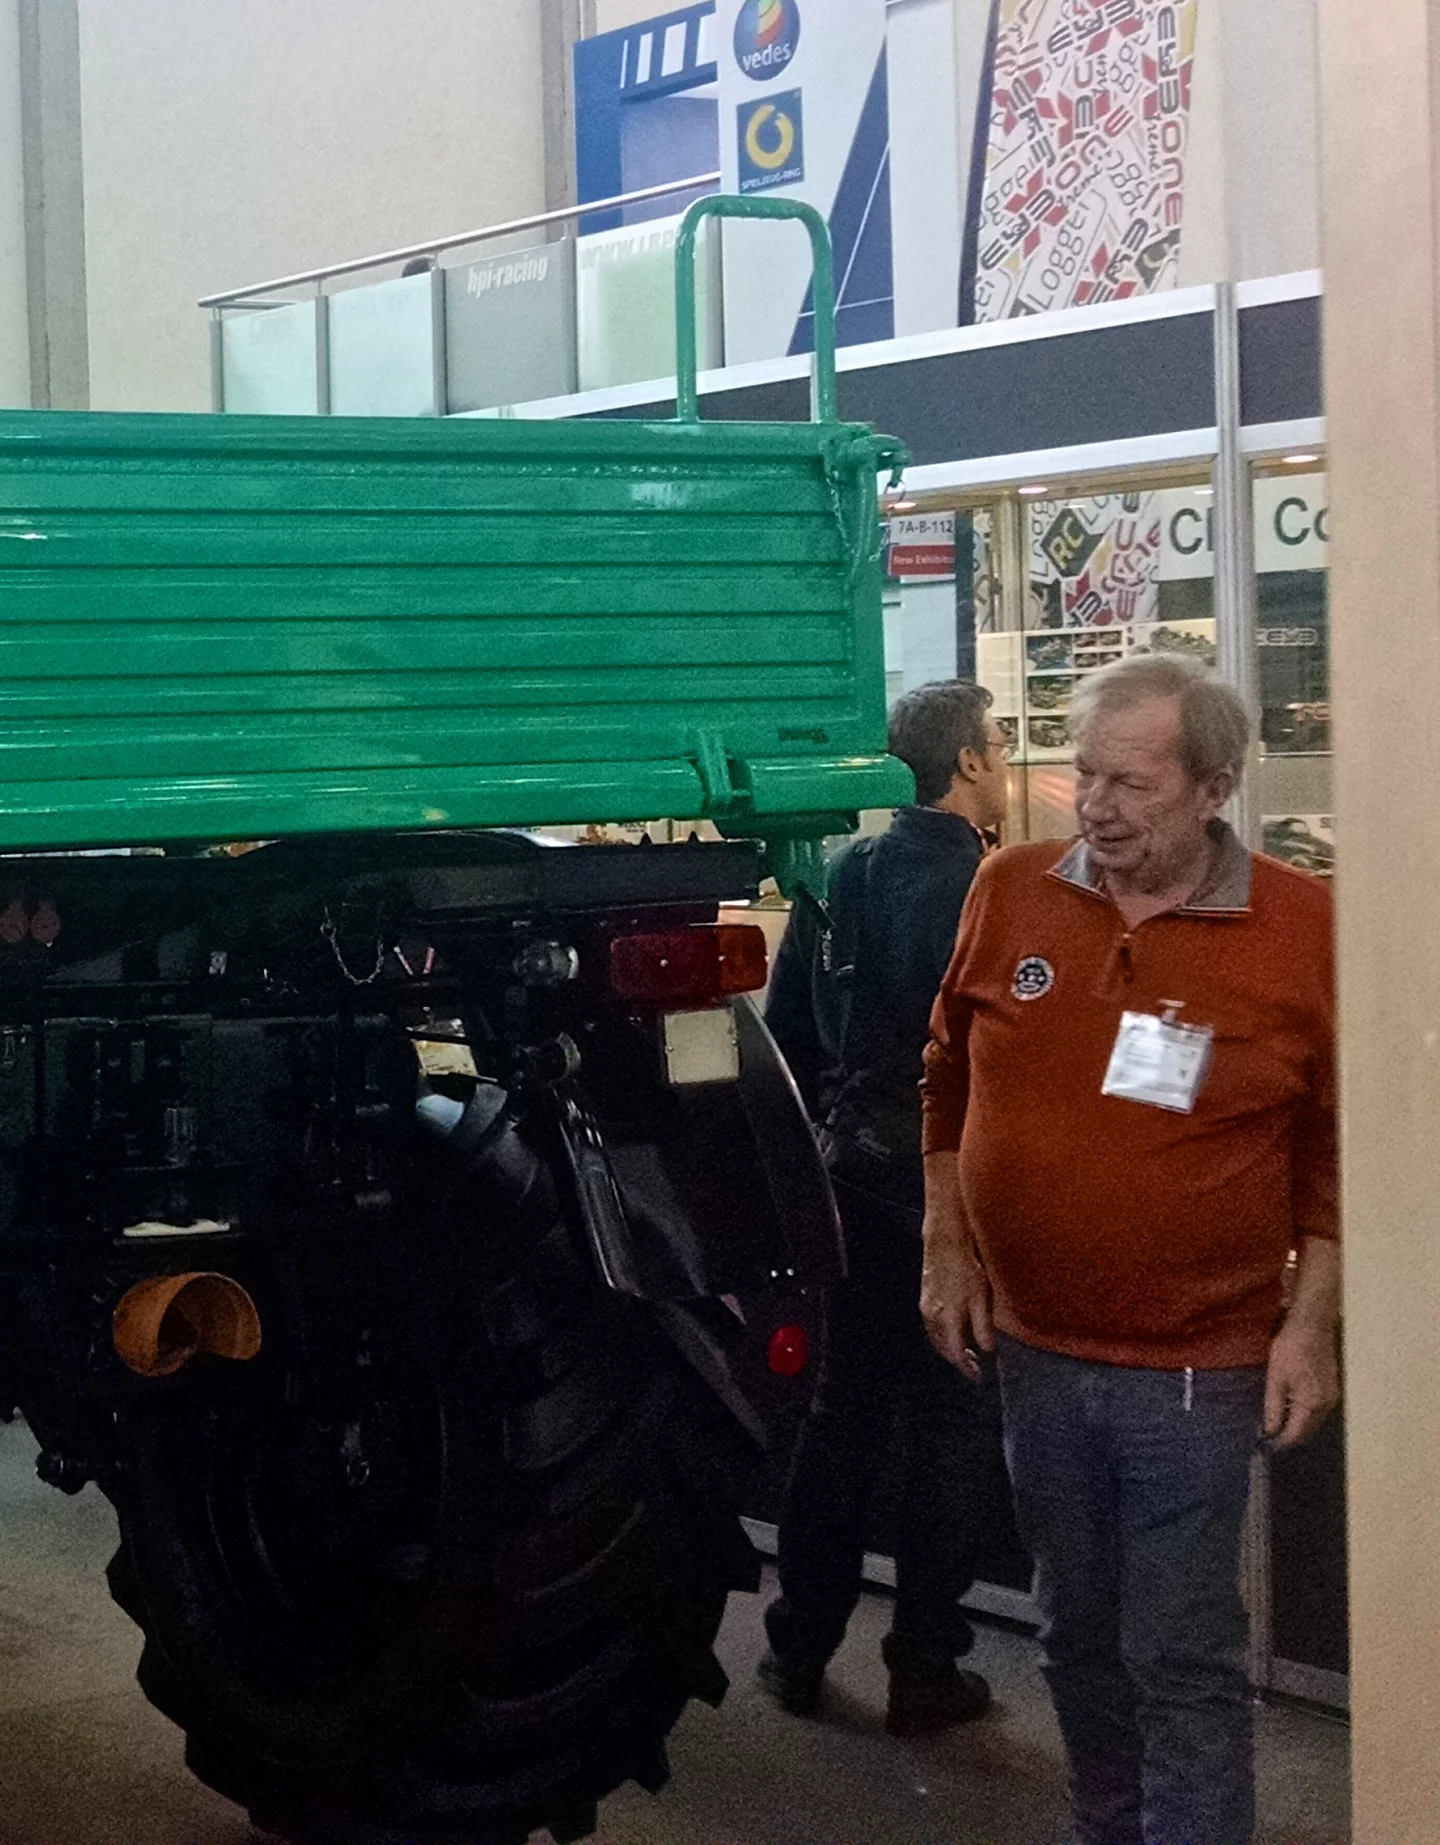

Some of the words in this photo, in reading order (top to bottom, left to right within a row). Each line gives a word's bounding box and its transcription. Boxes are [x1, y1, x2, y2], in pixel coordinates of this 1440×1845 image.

[742, 43, 792, 71] vedes
[467, 253, 548, 299] hpi-racing
[898, 519, 953, 534] 7A-B-112
